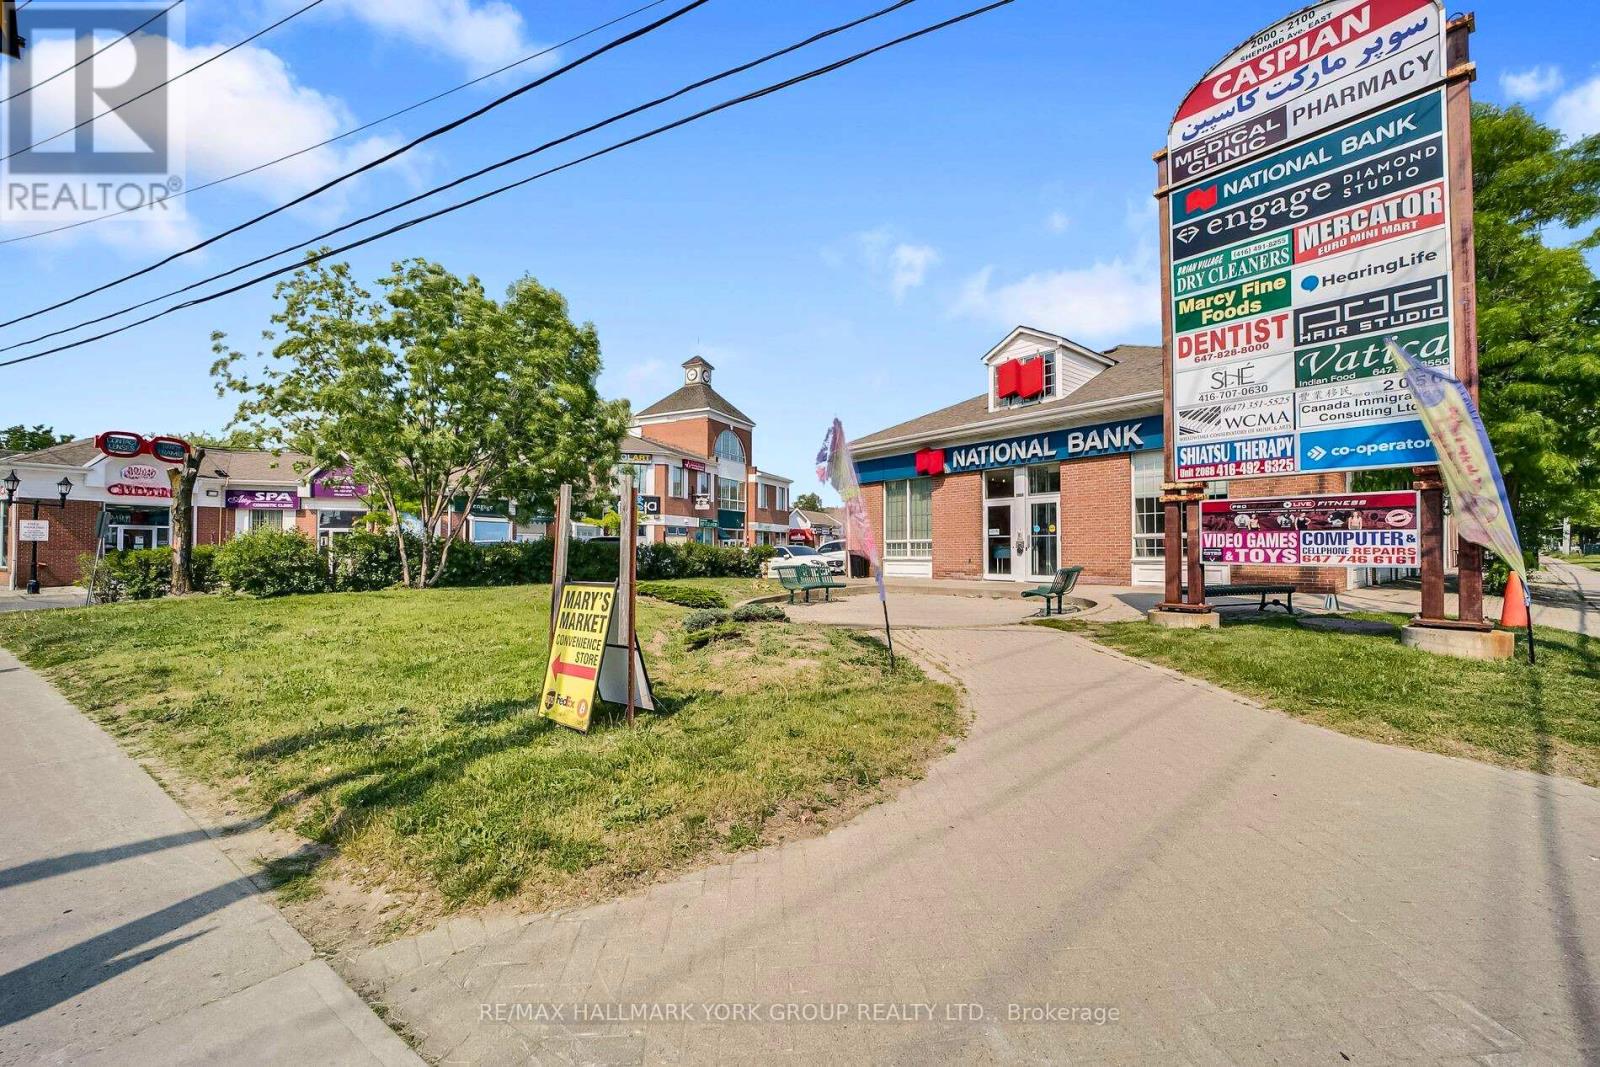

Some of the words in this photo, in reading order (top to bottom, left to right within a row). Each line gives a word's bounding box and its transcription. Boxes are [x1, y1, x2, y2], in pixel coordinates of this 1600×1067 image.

[1240, 37, 1285, 62] SHEPPARD
[1308, 12, 1333, 29] EAST
[1250, 30, 1277, 49] 2000
[1287, 10, 1315, 30] 2100
[1355, 17, 1428, 69] سوپر
[1212, 4, 1371, 99] CASPIAN
[1265, 55, 1347, 101] مارکت
[1292, 49, 1435, 126] PHARMACY
[1175, 119, 1281, 168] MEDICAL
[1187, 136, 1267, 175] CLINIC
[1223, 147, 1333, 198] NATIONAL
[1341, 112, 1418, 155] BANK
[1343, 146, 1438, 185] DIAMOND
[1343, 166, 1420, 198] STUDIO
[1206, 182, 1332, 234] engage
[1298, 186, 1443, 254] MERCATOR
[1318, 234, 1348, 256] EURO
[1350, 228, 1379, 244] MINI
[1381, 220, 1419, 235] MART
[1177, 271, 1206, 293] DRY
[1208, 247, 1290, 284] CLEANERS
[1197, 254, 1225, 270] VILLAGE
[1322, 250, 1438, 287] HearingLife
[1178, 290, 1237, 315] Marcy
[1241, 277, 1287, 299] Fine
[1201, 299, 1263, 325] Foods
[1299, 325, 1349, 343] HAIR
[1359, 306, 1444, 331] STUDIO
[1178, 313, 1290, 359] DENTIST
[1194, 342, 1270, 364] 647-828-8000
[1299, 334, 1449, 377] Vatica
[1211, 362, 1255, 390] SHÉ
[1299, 377, 1328, 387] Indian
[1330, 372, 1356, 383] Food
[1198, 384, 1269, 403] 416-707-0630
[1222, 402, 1246, 413] (647)
[1301, 400, 1350, 414] Canada
[1355, 392, 1413, 407] Immigra
[1224, 411, 1291, 430] WCMA
[1319, 405, 1392, 422] Consulting
[952, 436, 1058, 470] NATIONAL
[1067, 422, 1145, 454] BANK
[1179, 443, 1230, 466] SHIATSU
[1234, 436, 1295, 461] THERAPY
[1179, 467, 1195, 478] Unit
[1216, 458, 1294, 476] 416-492-6325
[254, 492, 293, 501] SPA
[1317, 499, 1367, 507] FITNESS
[1203, 533, 1243, 548] VIDEO
[1246, 532, 1298, 548] GAMES
[1302, 531, 1404, 546] COMPUTER
[1406, 534, 1416, 543] &
[1302, 546, 1350, 555] CELLPHONE
[1352, 547, 1417, 556] REPAIRS
[1225, 550, 1234, 561] &
[1235, 548, 1298, 563] TOYS
[1302, 555, 1331, 563] 647
[1339, 555, 1368, 564] 746
[1373, 555, 1416, 564] 6161
[563, 590, 611, 612] MARY'S
[558, 611, 608, 634] MARKET
[555, 633, 602, 651] CONVENIENCE
[575, 650, 599, 667] STORE
